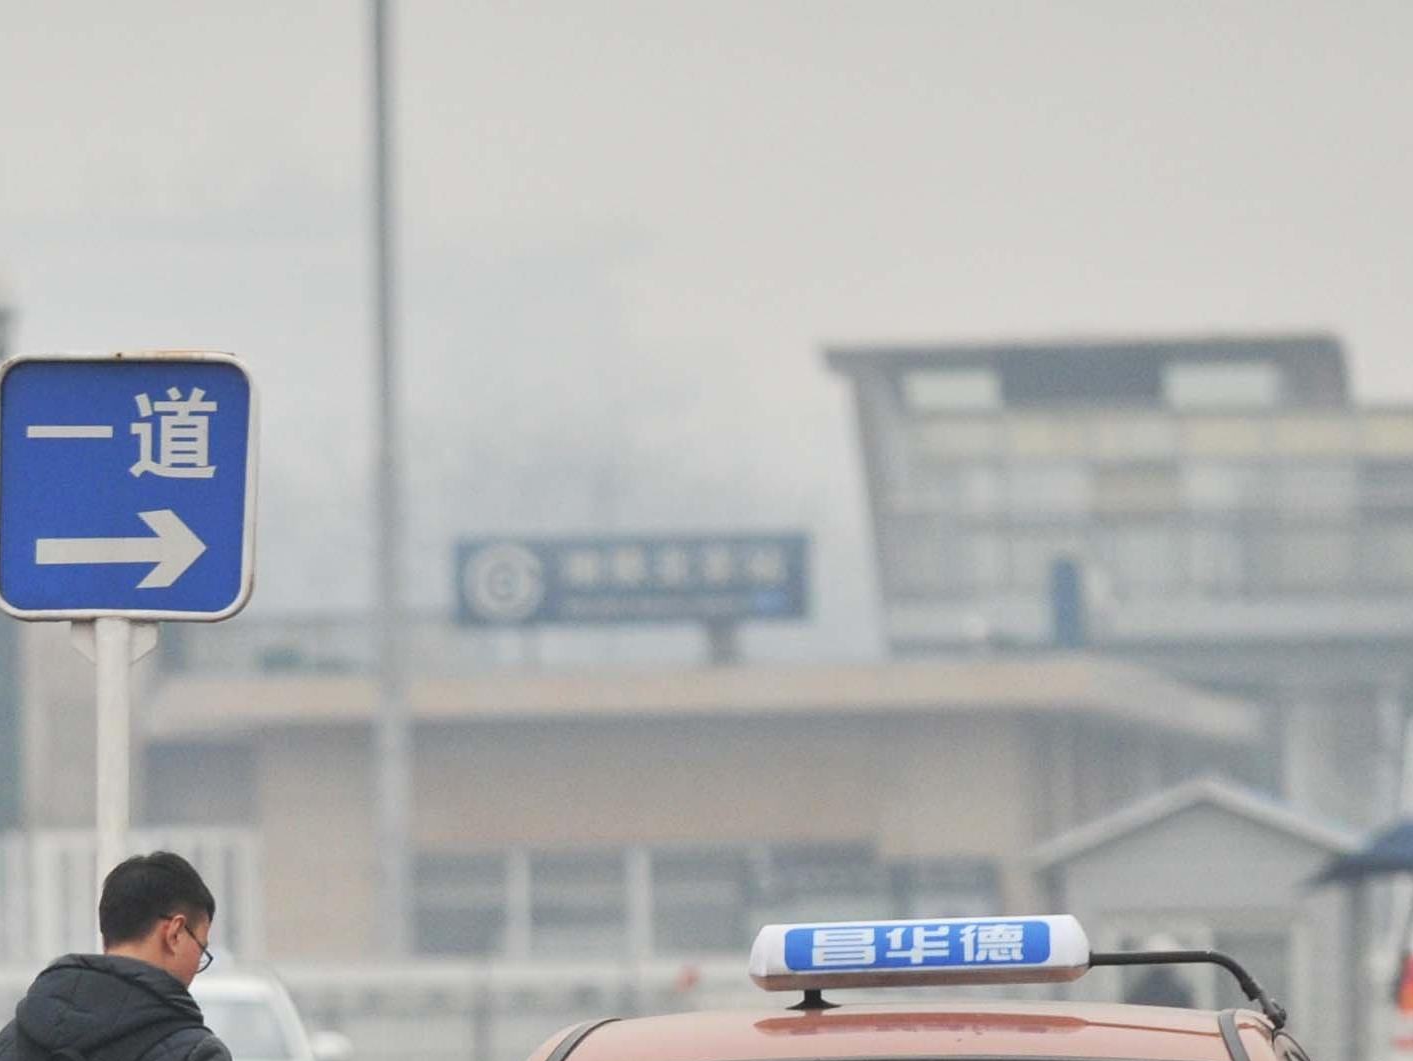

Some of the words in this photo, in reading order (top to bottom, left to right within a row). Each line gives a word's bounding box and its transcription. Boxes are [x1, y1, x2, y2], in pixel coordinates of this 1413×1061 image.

[26, 386, 218, 479] 一道
[811, 923, 1025, 966] 昌华德
